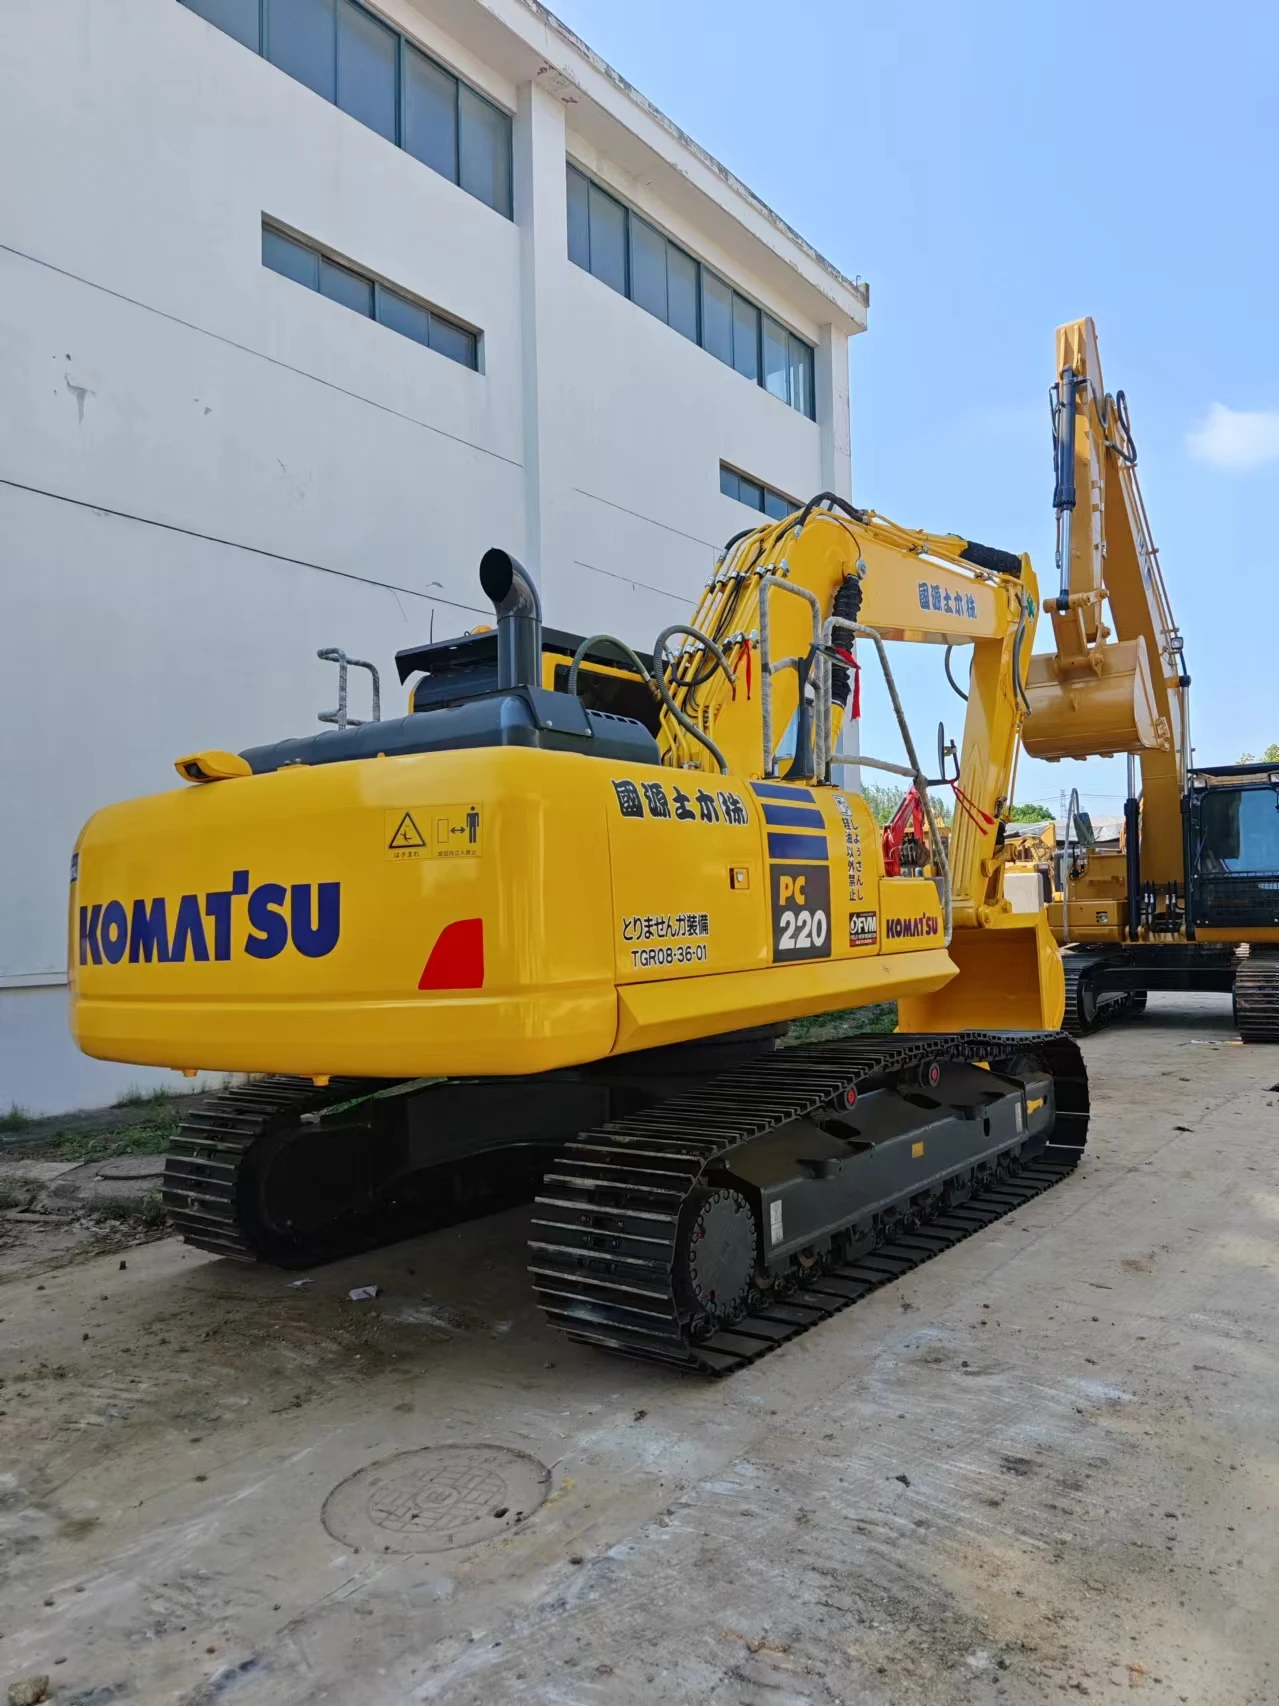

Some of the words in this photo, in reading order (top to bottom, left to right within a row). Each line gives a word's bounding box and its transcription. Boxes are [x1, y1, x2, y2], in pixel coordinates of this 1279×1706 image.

[779, 876, 805, 905] PC
[79, 870, 341, 966] KOMATSU
[779, 910, 827, 949] 220
[886, 912, 938, 939] KOMATSU
[631, 945, 707, 967] TGR08-36-01
